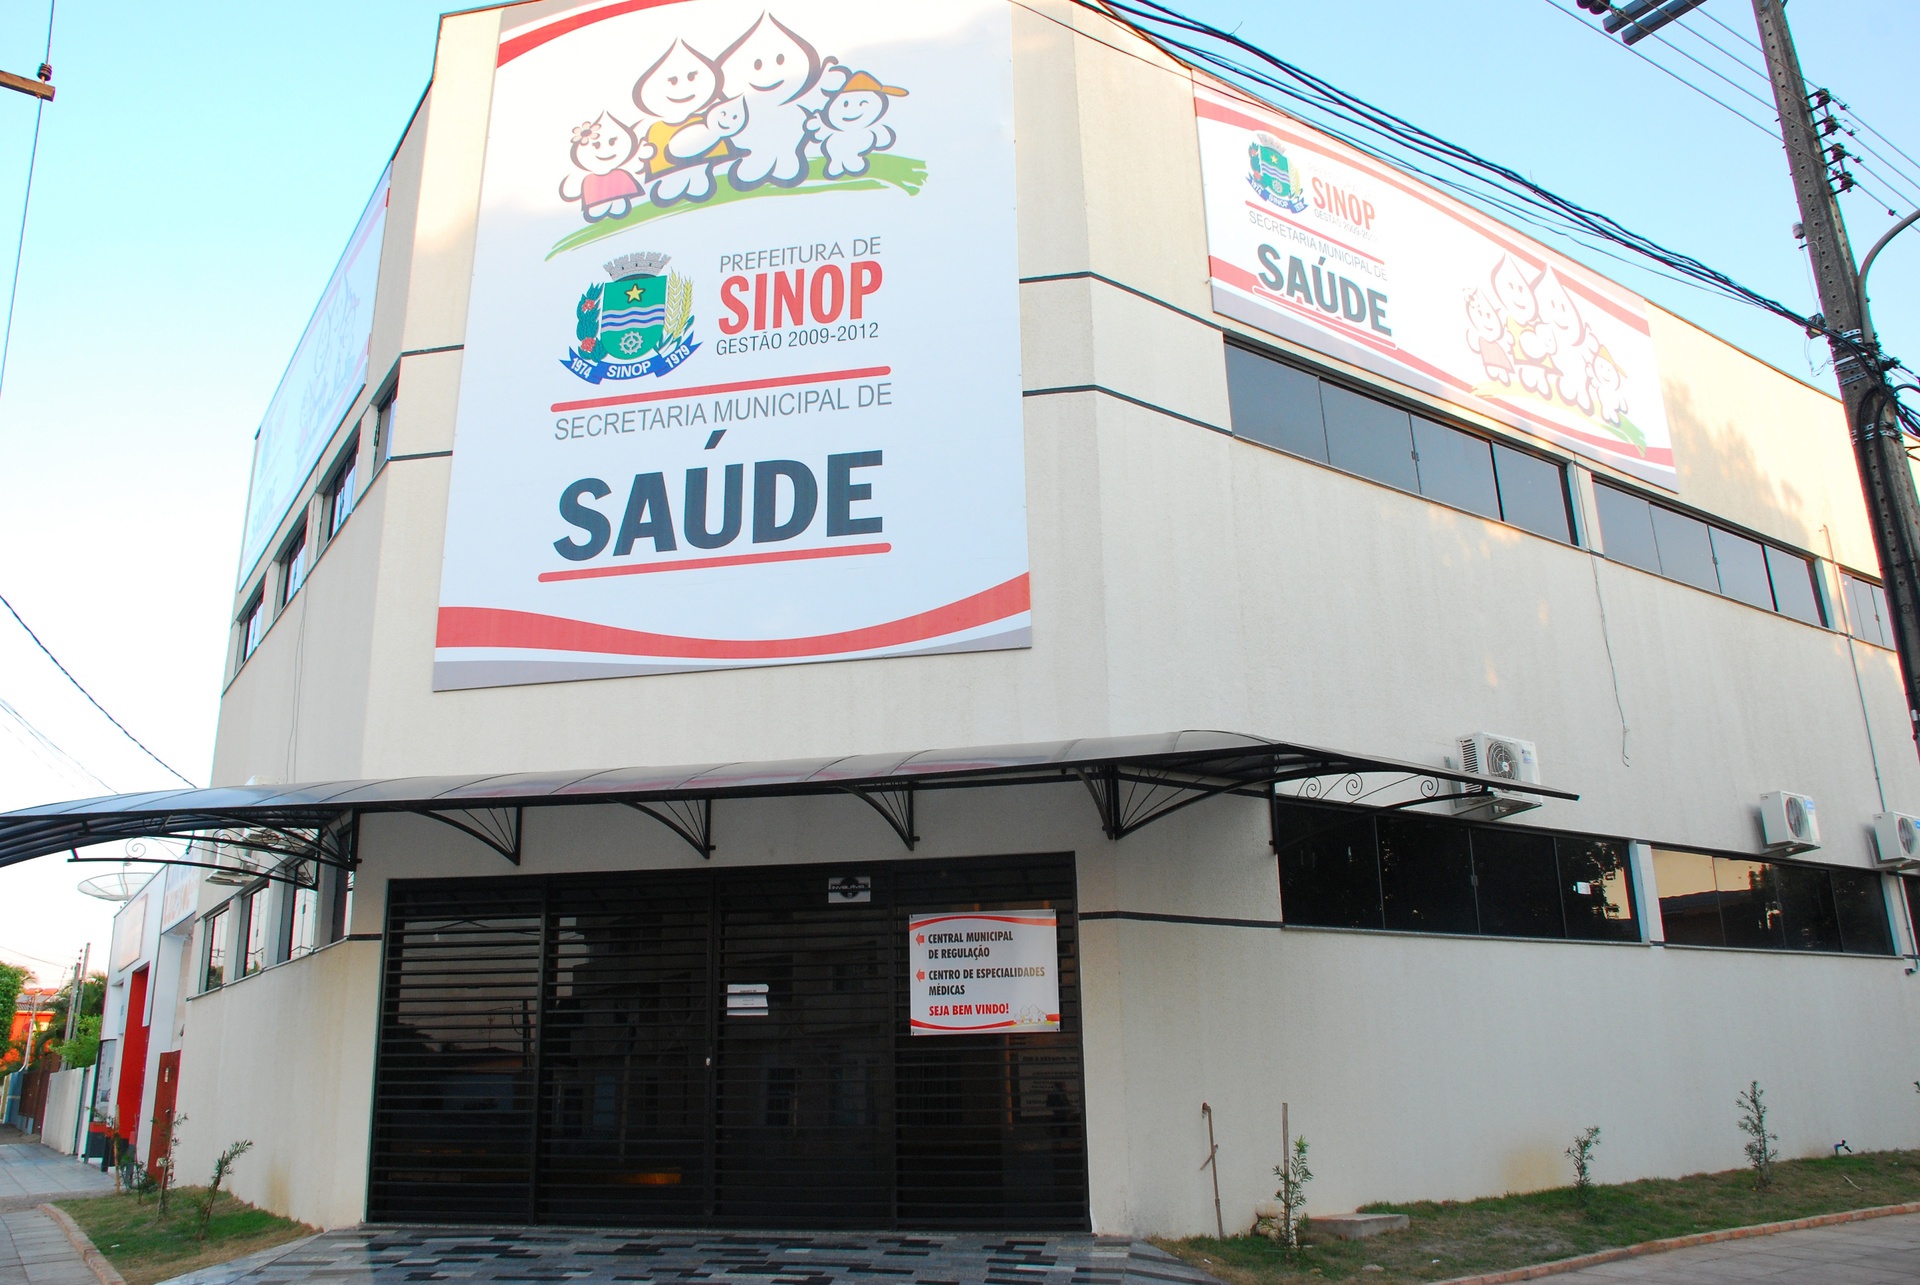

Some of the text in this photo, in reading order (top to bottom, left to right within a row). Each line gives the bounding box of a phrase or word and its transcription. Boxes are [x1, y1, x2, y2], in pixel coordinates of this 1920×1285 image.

[1311, 176, 1375, 231] SINOP
[719, 236, 881, 273] PREFEITURA DE
[1249, 210, 1388, 282] SECRETARIA MUNICIPAL DE
[718, 260, 883, 335] SINOP
[1257, 243, 1392, 337] SAÚDE
[716, 322, 879, 356] GESTÃO 2009-2012
[570, 357, 593, 379] 1974
[606, 360, 651, 378] SINOP
[665, 344, 690, 369] 1979
[554, 382, 892, 441] SECRETARIA MUNICIPAL DE
[553, 429, 883, 562] SAÚDE
[928, 931, 1013, 944] CENTRAL MUNICIPAL
[928, 945, 990, 960] DE REGULAÇÃO
[928, 966, 1045, 980] CENTRO DE ESPECIALIDADES
[929, 983, 965, 996] MÉDICAS
[929, 1003, 1010, 1016] SEJA BEM VINDO!
